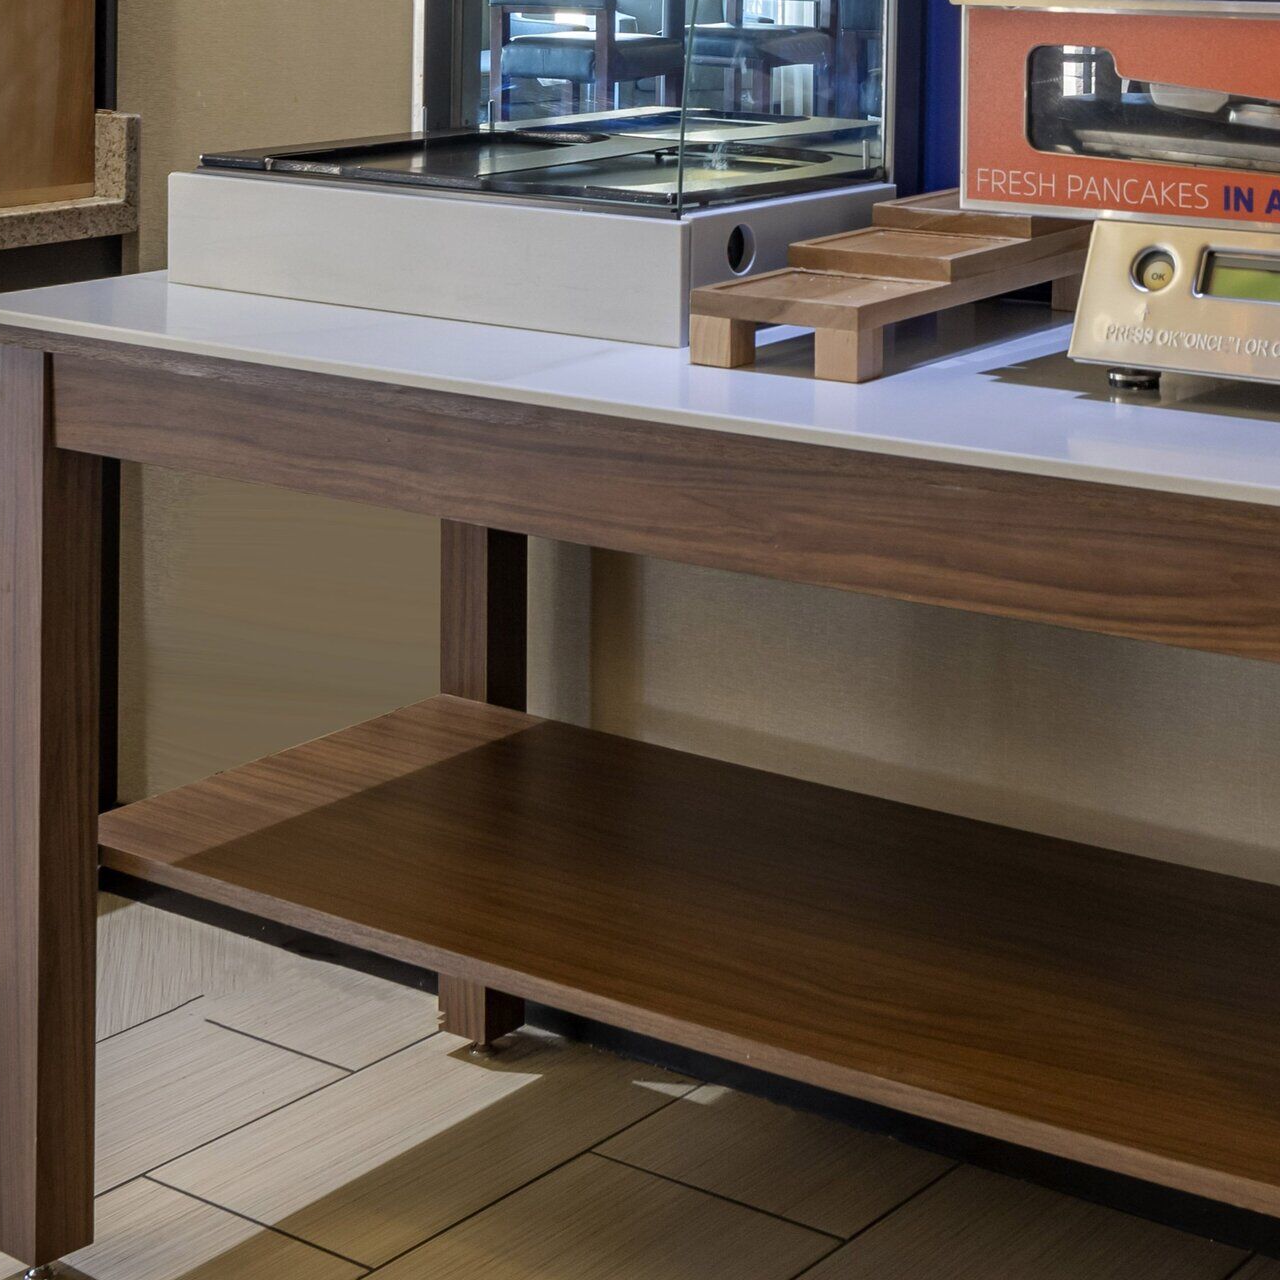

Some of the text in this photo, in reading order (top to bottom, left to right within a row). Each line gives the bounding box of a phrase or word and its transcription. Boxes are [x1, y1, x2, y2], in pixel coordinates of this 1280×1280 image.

[976, 168, 1056, 198] FRESH
[1066, 176, 1209, 209] PANCAKES
[1223, 186, 1255, 213] IN
[1152, 272, 1165, 281] OK
[1156, 330, 1180, 346] OK
